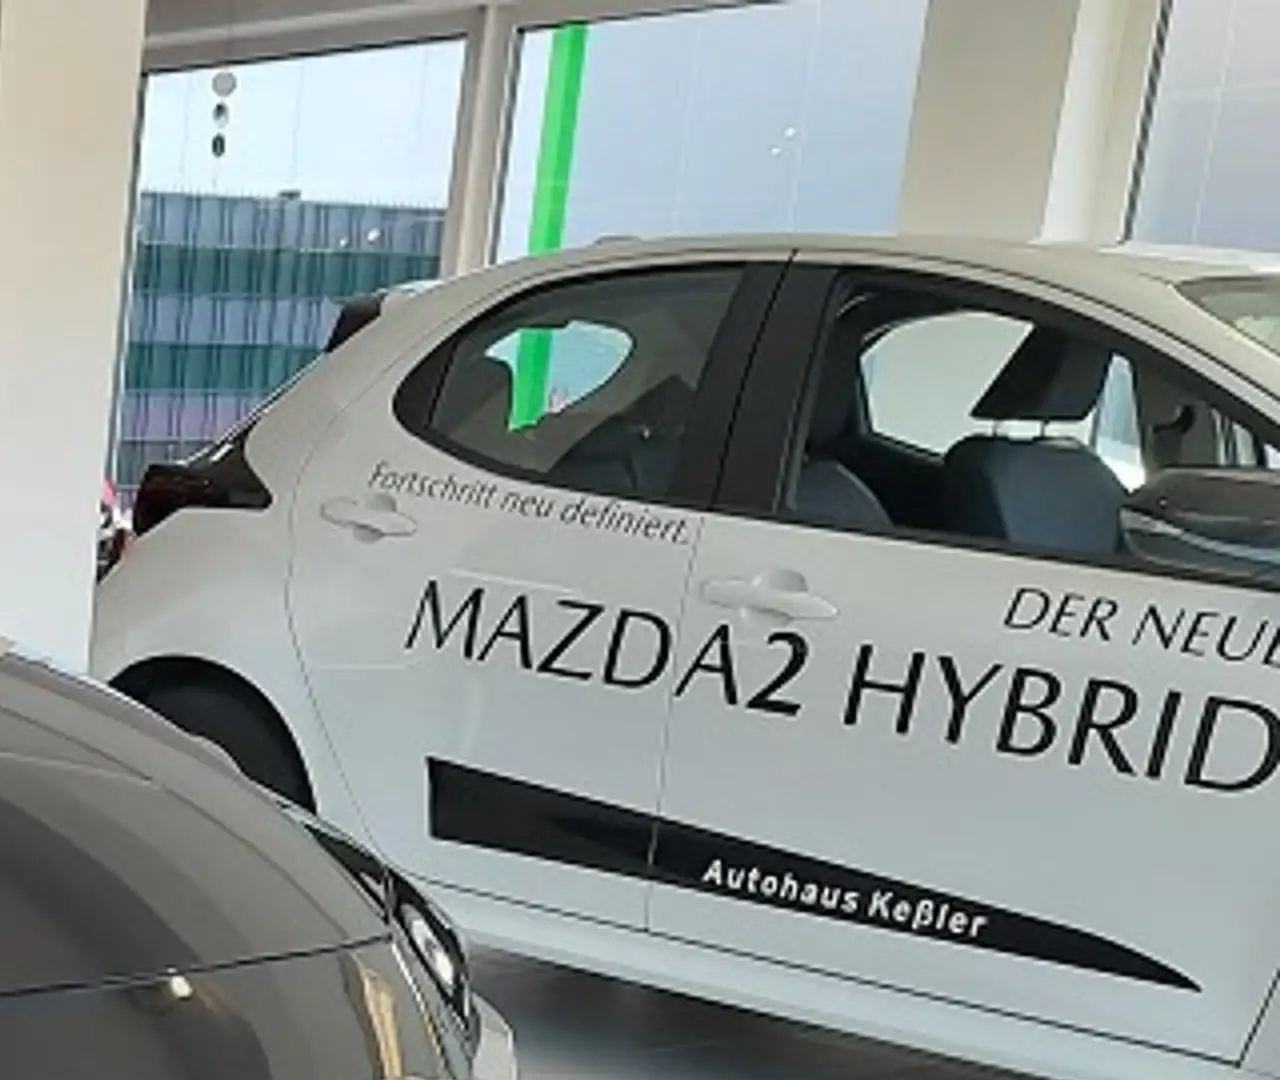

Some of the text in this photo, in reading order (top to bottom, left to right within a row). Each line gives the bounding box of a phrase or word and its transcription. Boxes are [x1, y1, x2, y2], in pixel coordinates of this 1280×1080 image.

[368, 460, 688, 545] Fortschritt neu definiert.
[1003, 587, 1119, 642] DER
[405, 578, 1280, 791] MAZDA2 HYBRID
[701, 858, 989, 937] Autohaus Keßler
